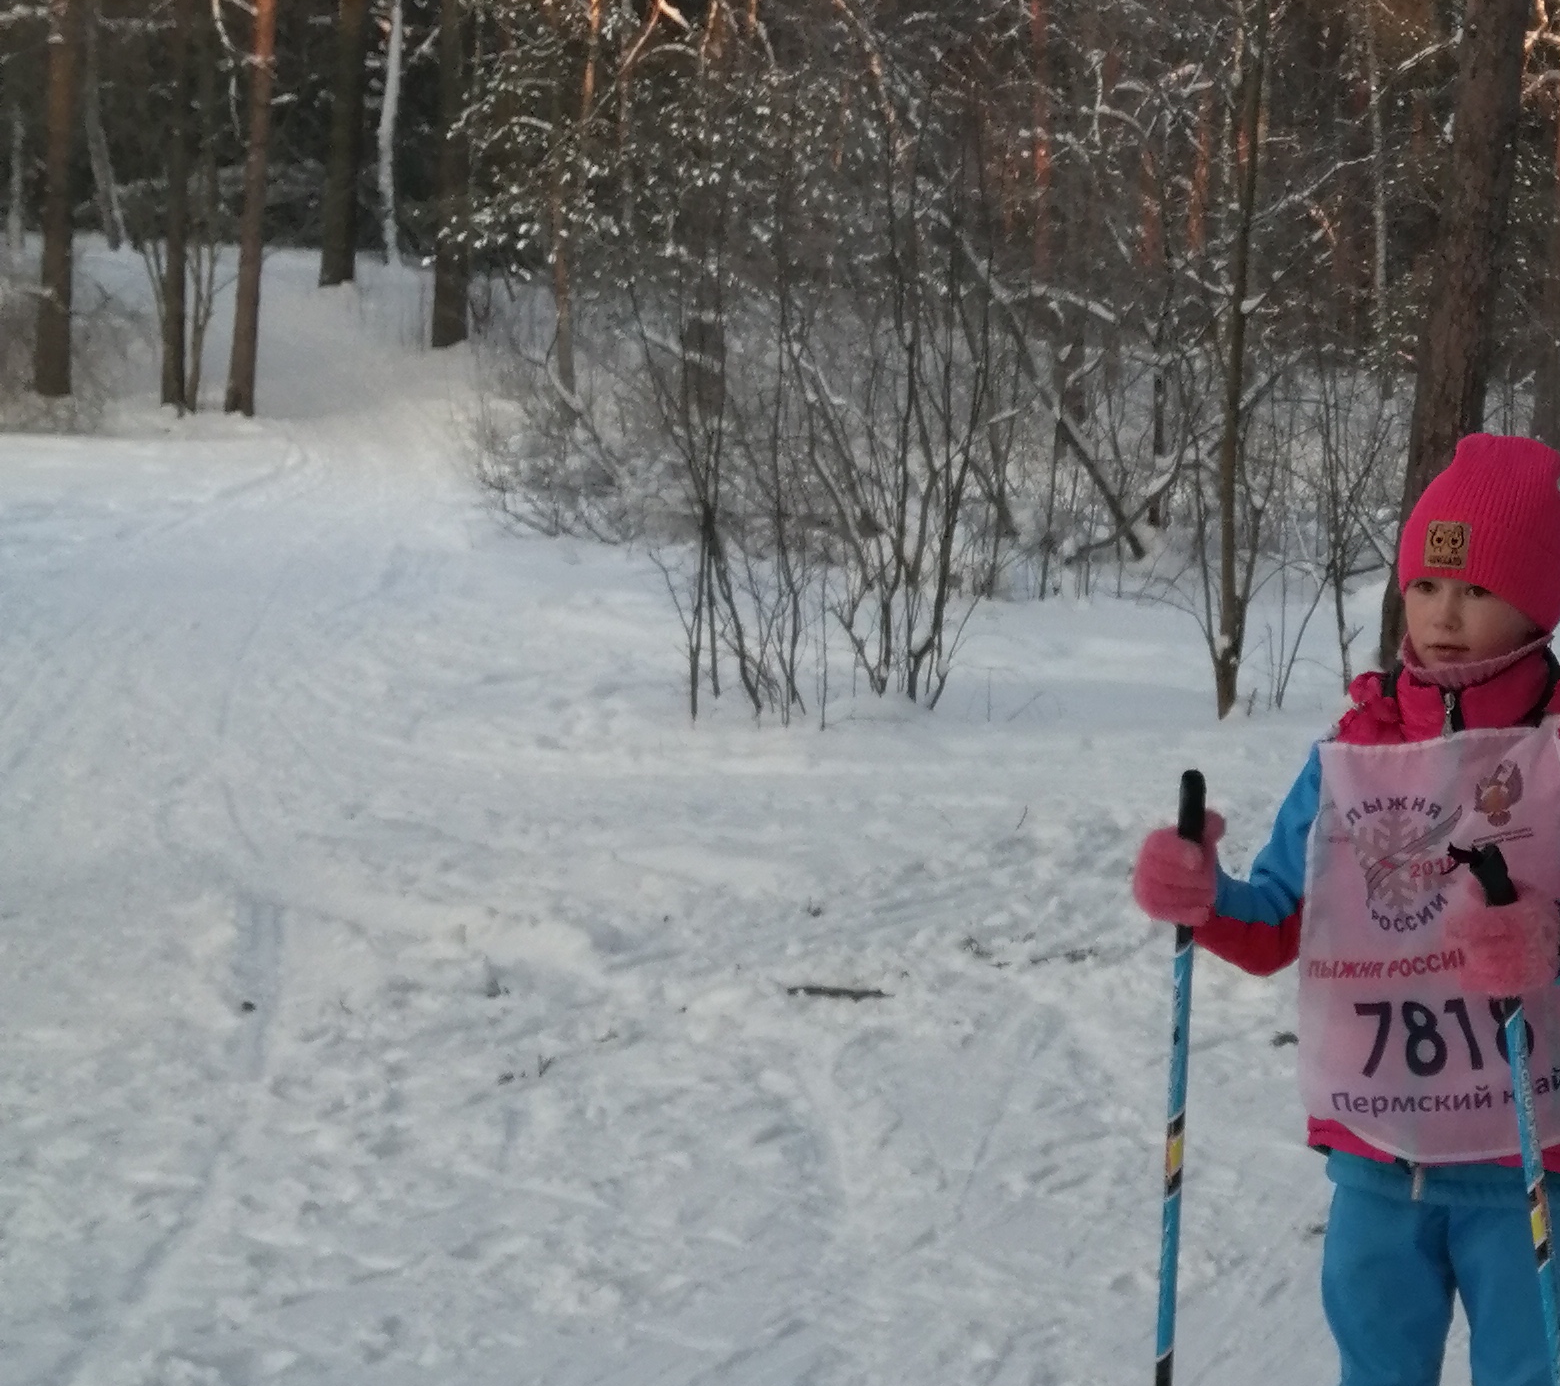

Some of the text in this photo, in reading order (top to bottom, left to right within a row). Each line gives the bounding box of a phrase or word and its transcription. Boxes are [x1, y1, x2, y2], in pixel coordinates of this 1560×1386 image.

[1345, 796, 1442, 826] ЛЫЖНЯ
[1371, 893, 1449, 933] РОССИИ
[1308, 958, 1384, 979] ЛЫЖНЯ
[1331, 1085, 1493, 1117] Пермский
